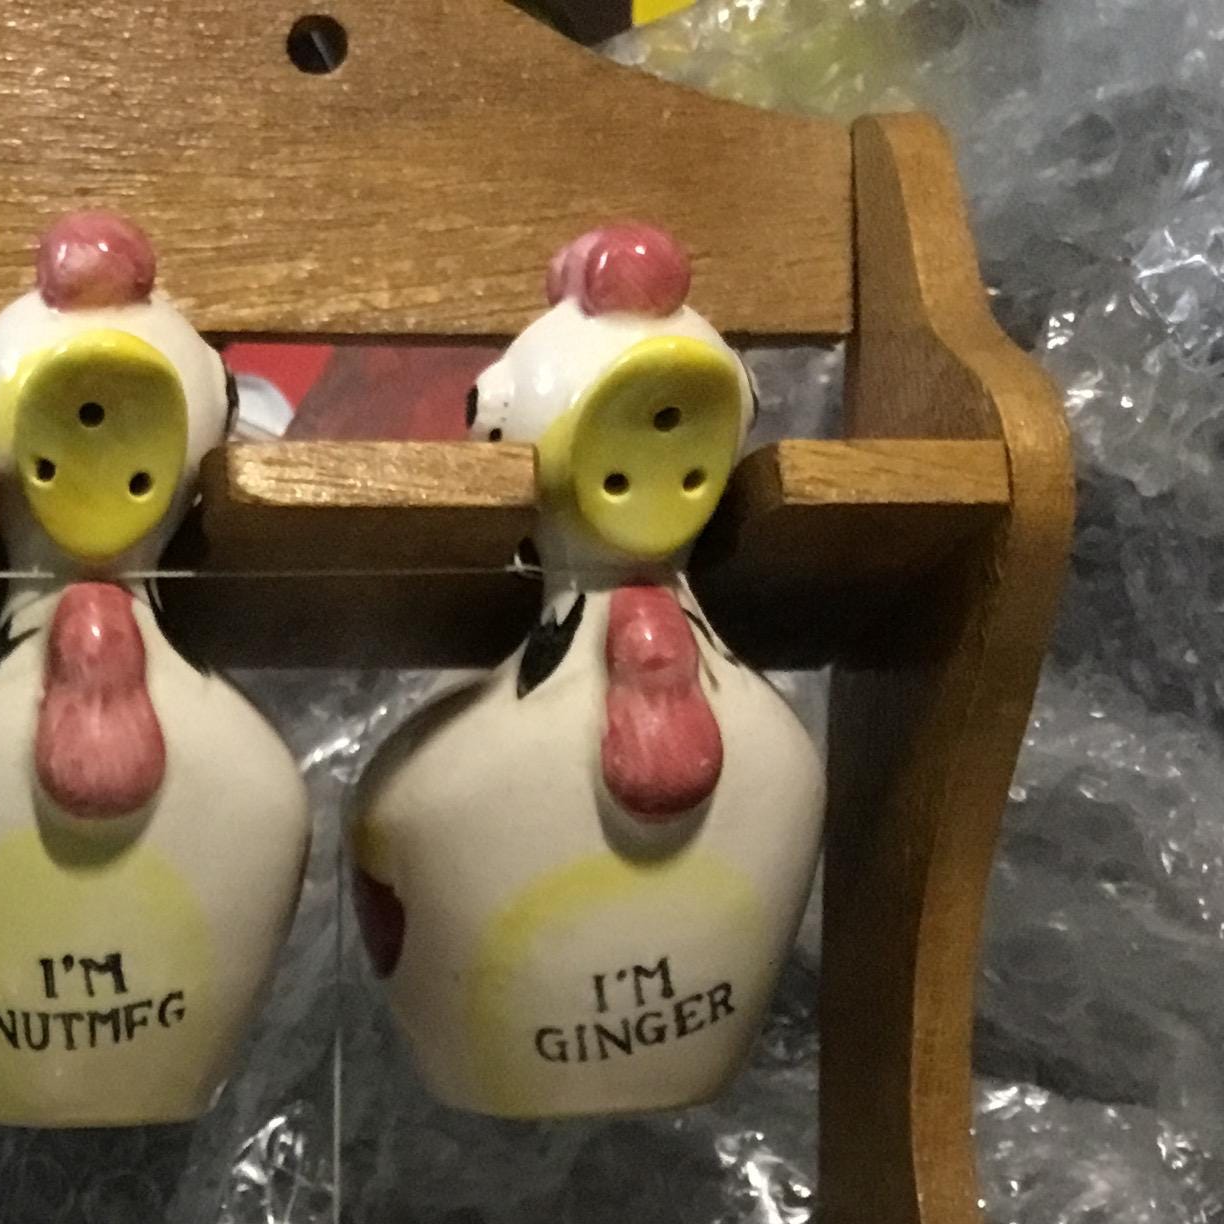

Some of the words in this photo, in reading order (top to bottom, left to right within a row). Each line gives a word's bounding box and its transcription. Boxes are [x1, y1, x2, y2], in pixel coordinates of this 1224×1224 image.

[39, 952, 128, 999] I'M
[592, 956, 675, 1013] I'M
[534, 980, 736, 1063] GINGER
